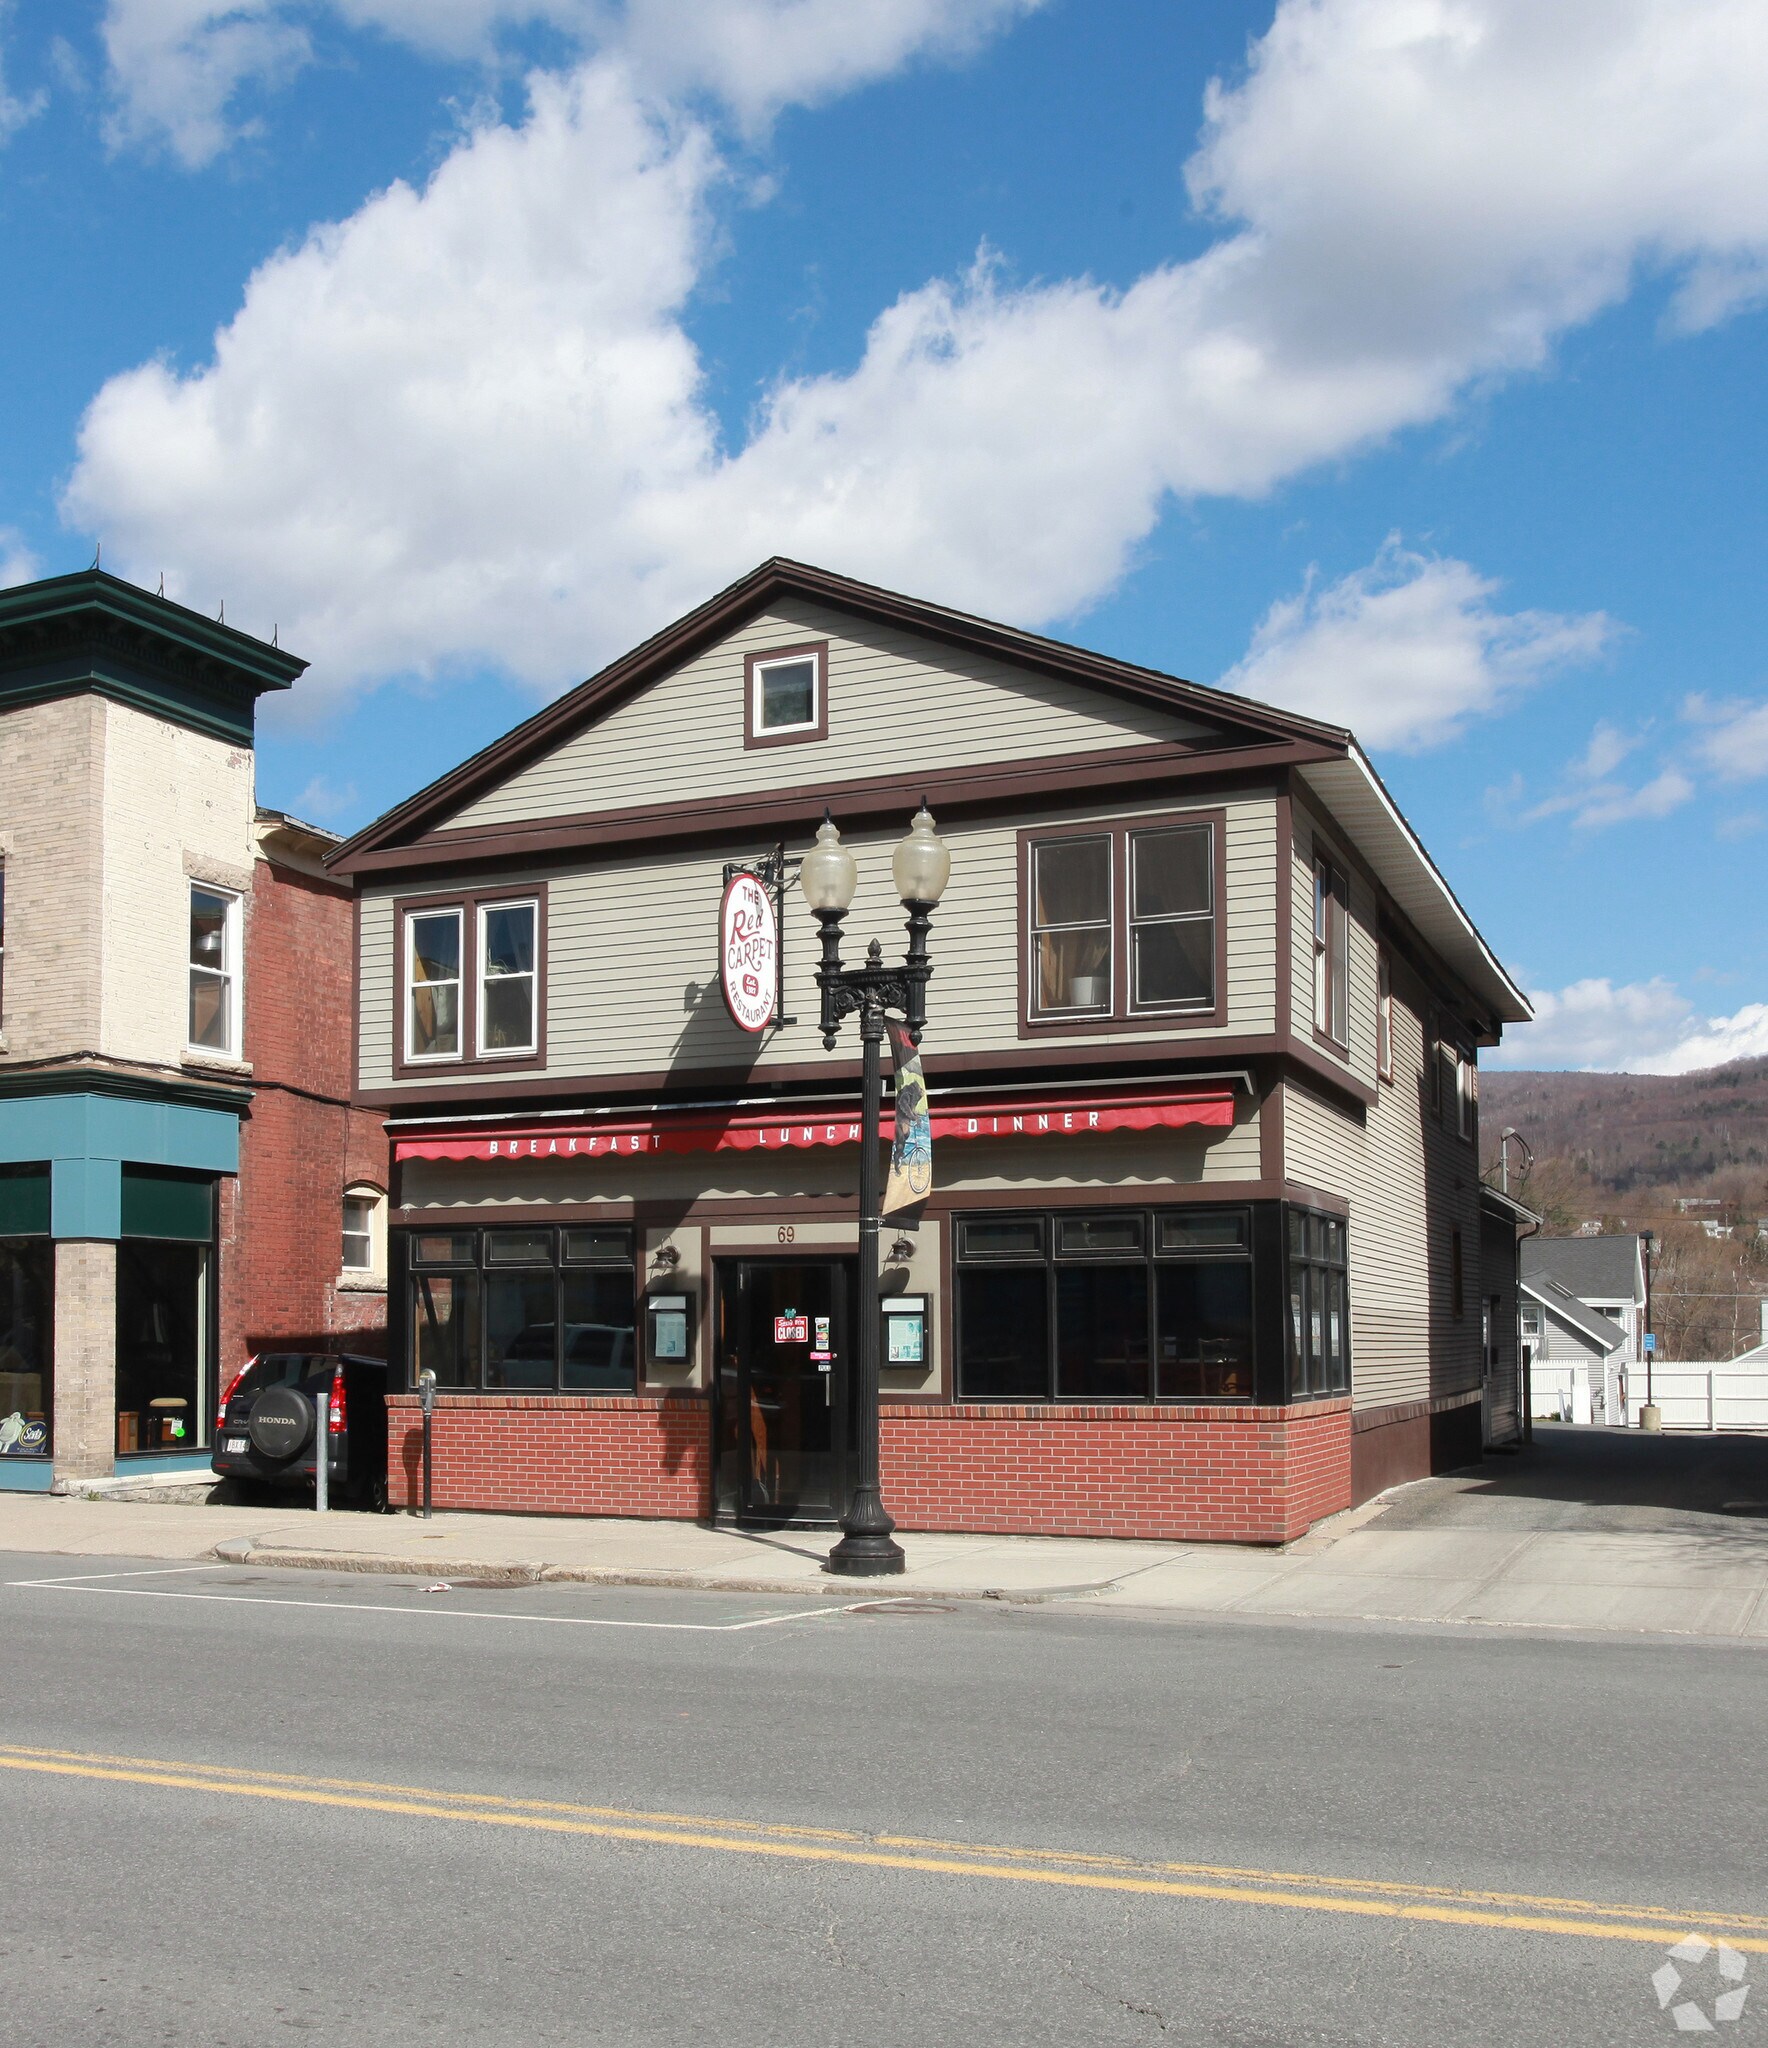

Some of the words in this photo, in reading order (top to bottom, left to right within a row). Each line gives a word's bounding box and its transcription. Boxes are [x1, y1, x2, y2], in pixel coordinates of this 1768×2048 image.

[742, 886, 760, 905] THE
[730, 909, 764, 945] Red
[728, 937, 773, 972] CARPET
[729, 980, 772, 1022] RESTAURANT
[489, 1135, 660, 1154] BREAKFAST
[759, 1124, 859, 1143] LUNCH
[967, 1111, 1099, 1132] DINNER
[778, 1226, 795, 1243] 69
[778, 1327, 804, 1339] CLOSED
[258, 1416, 297, 1426] HONDA
